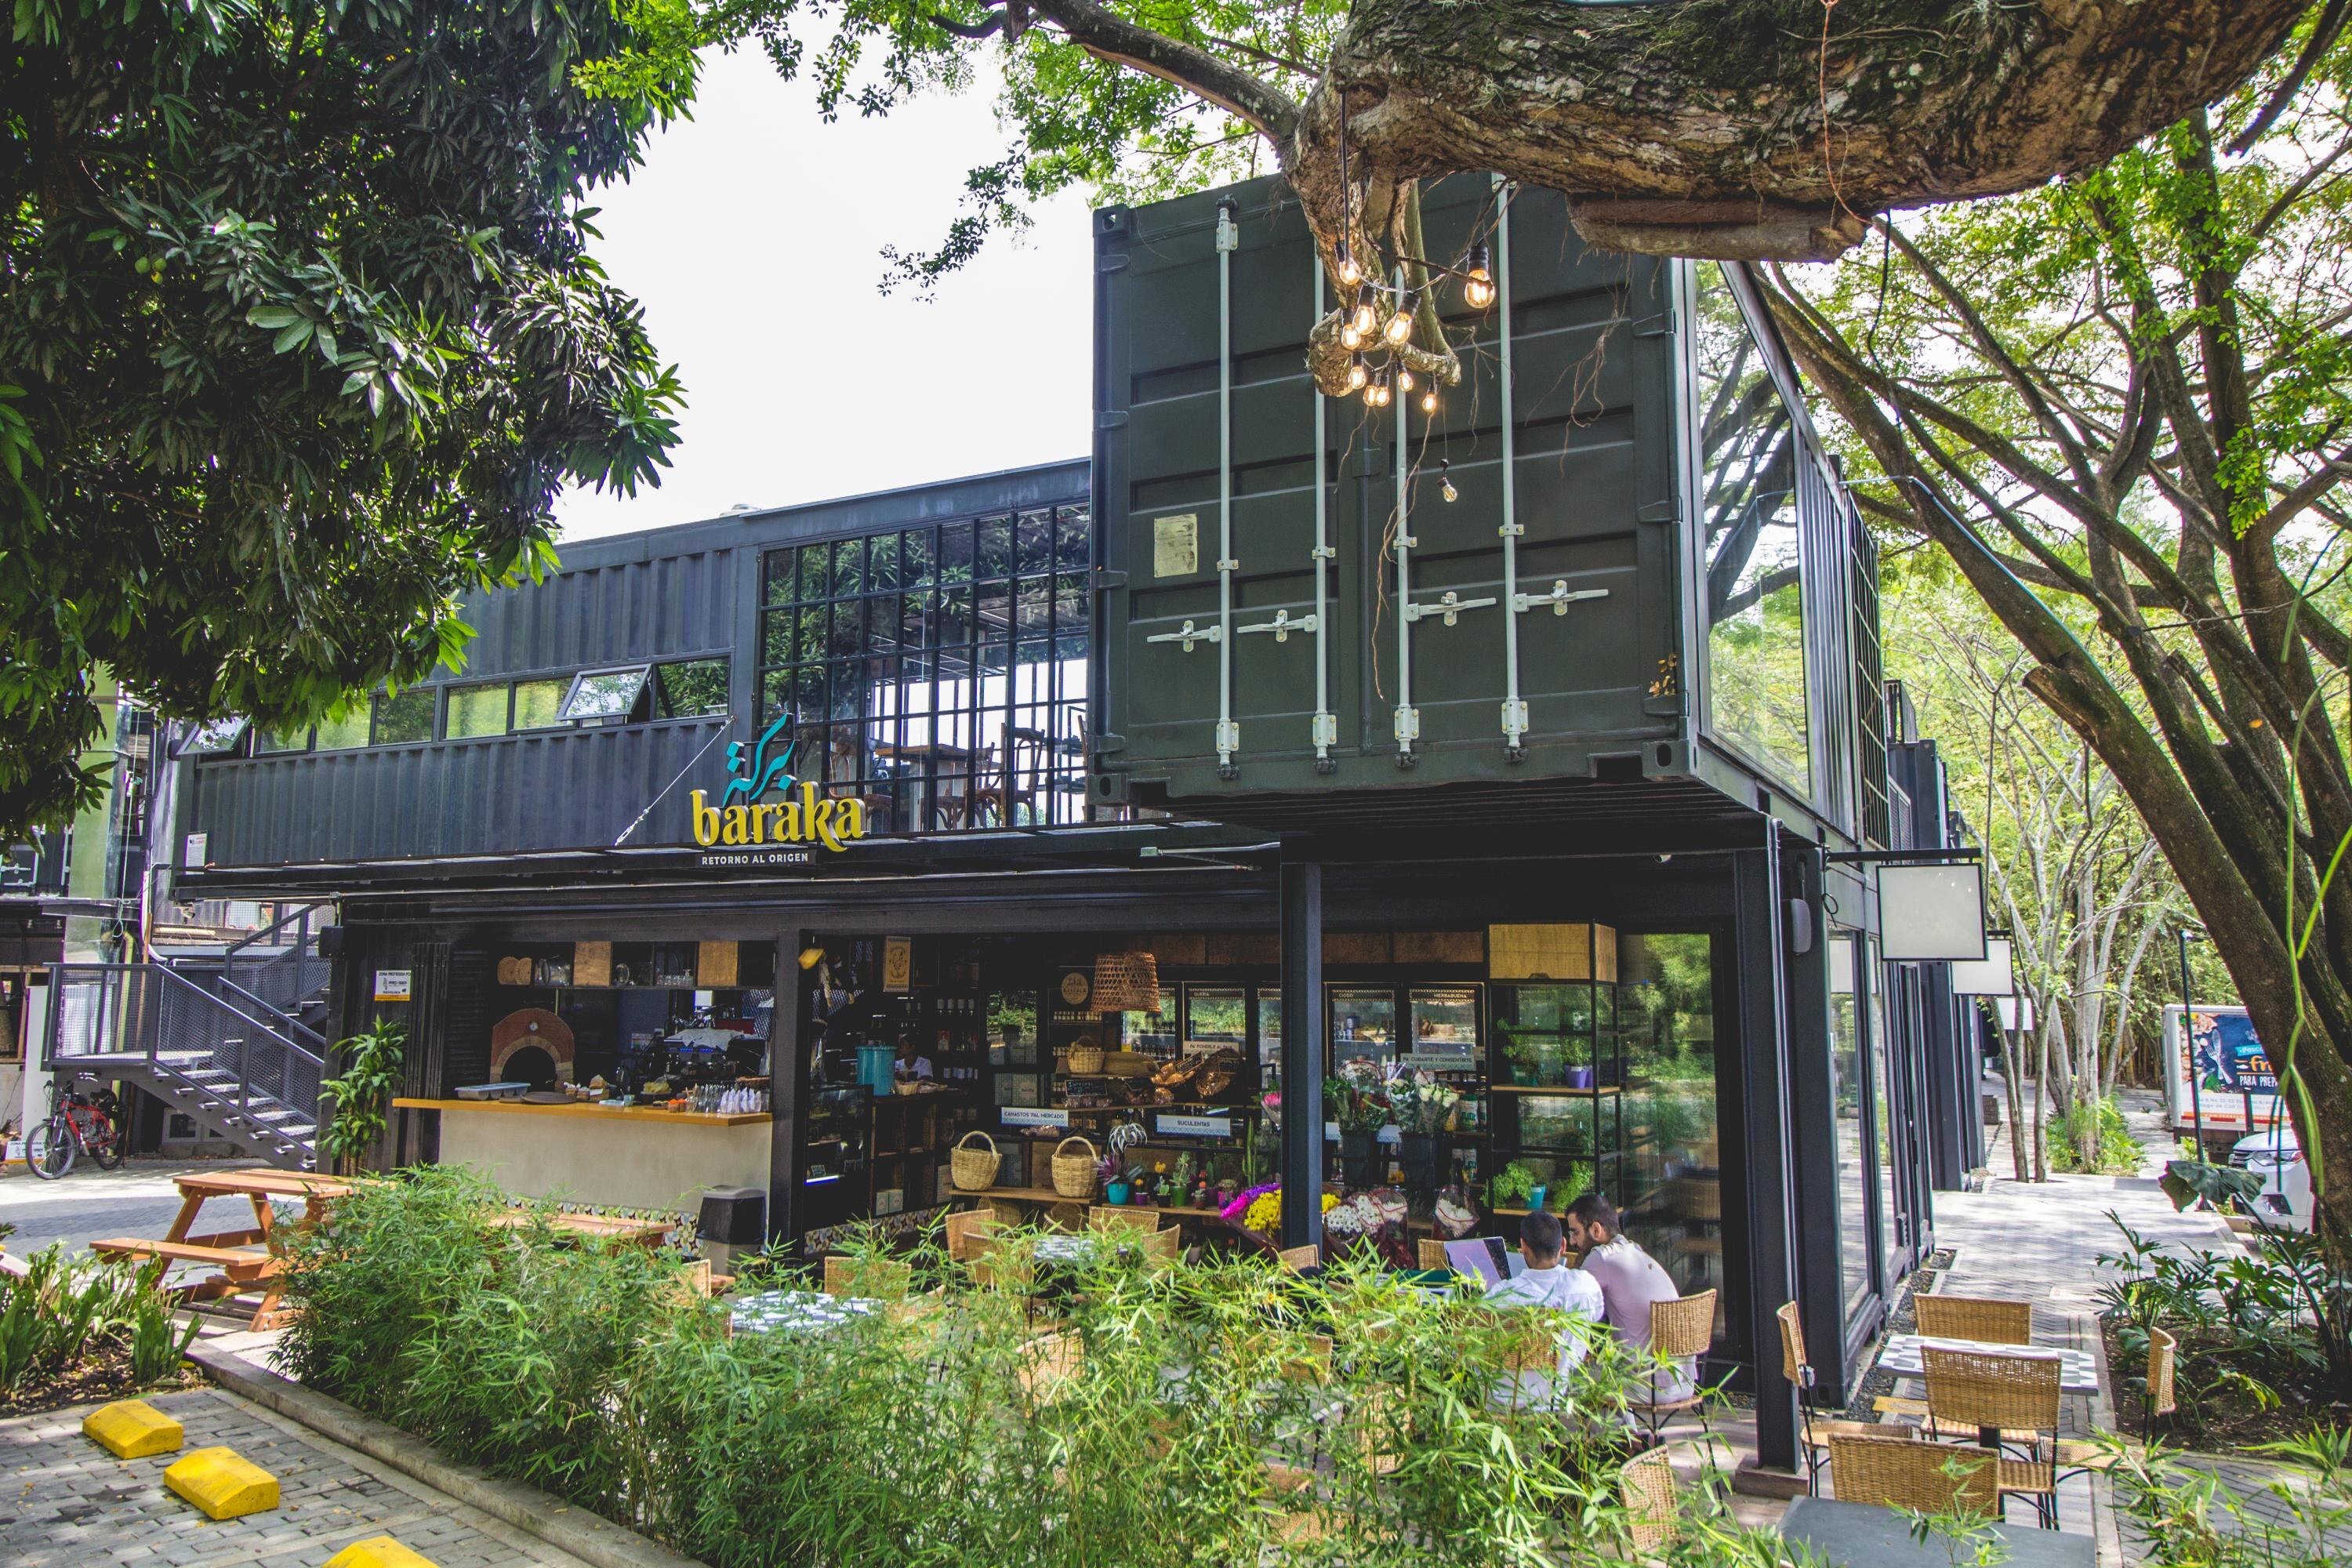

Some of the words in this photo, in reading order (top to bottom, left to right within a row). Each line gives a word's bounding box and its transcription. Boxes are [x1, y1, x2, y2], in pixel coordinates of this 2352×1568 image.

[690, 781, 869, 852] baraka
[702, 855, 749, 866] RETORNO
[753, 855, 765, 864] AL
[769, 853, 808, 863] ORIGEN
[2239, 1075, 2257, 1087] PARA
